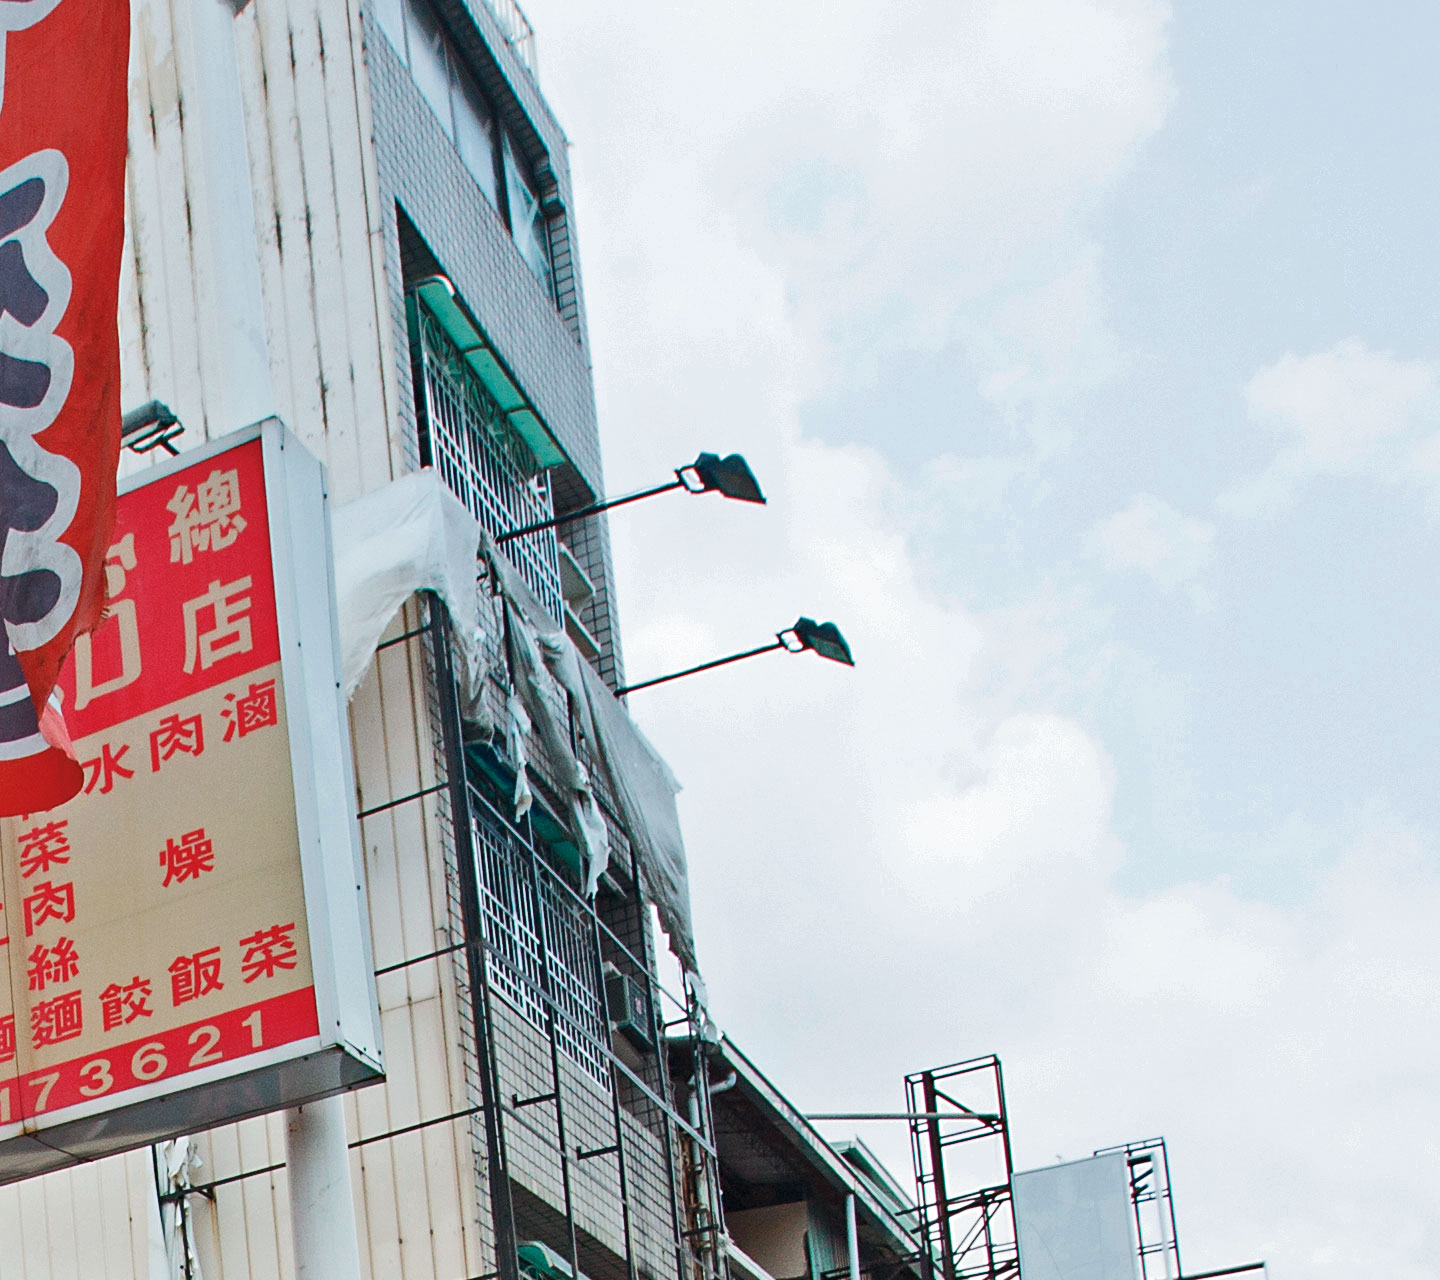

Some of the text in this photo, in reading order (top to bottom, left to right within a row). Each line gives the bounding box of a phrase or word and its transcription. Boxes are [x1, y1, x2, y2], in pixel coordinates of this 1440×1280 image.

[167, 466, 258, 677] 總店
[18, 815, 84, 1054] 菜肉絲麵
[81, 740, 156, 1033] 水餃
